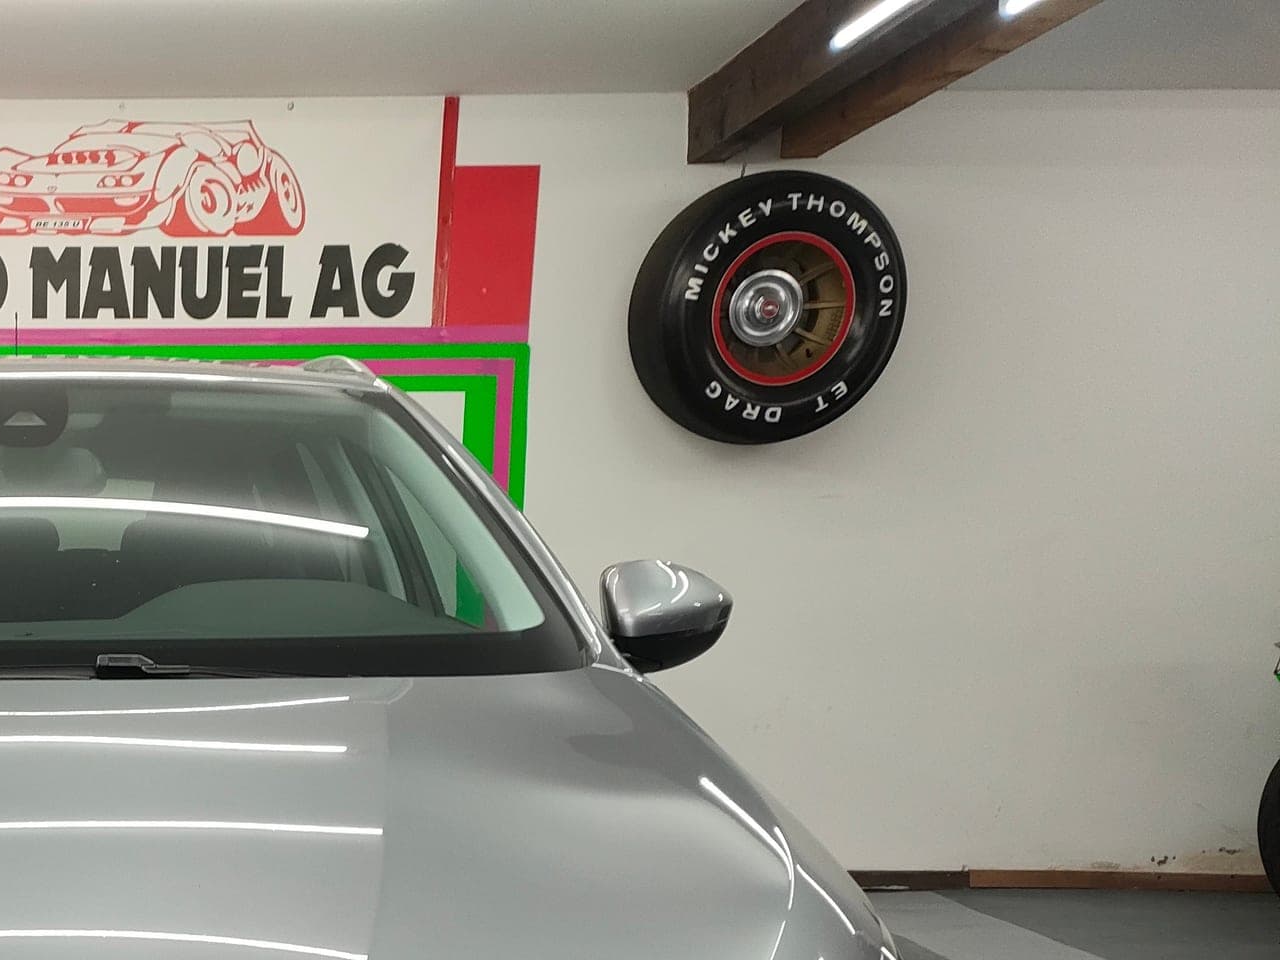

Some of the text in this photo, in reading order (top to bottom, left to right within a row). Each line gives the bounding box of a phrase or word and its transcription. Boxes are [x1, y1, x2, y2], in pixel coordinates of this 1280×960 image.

[29, 243, 293, 319] MANUEL
[309, 242, 416, 319] AG
[684, 193, 894, 318] MICKEY THOMPSON
[704, 380, 849, 423] ET DRAG
